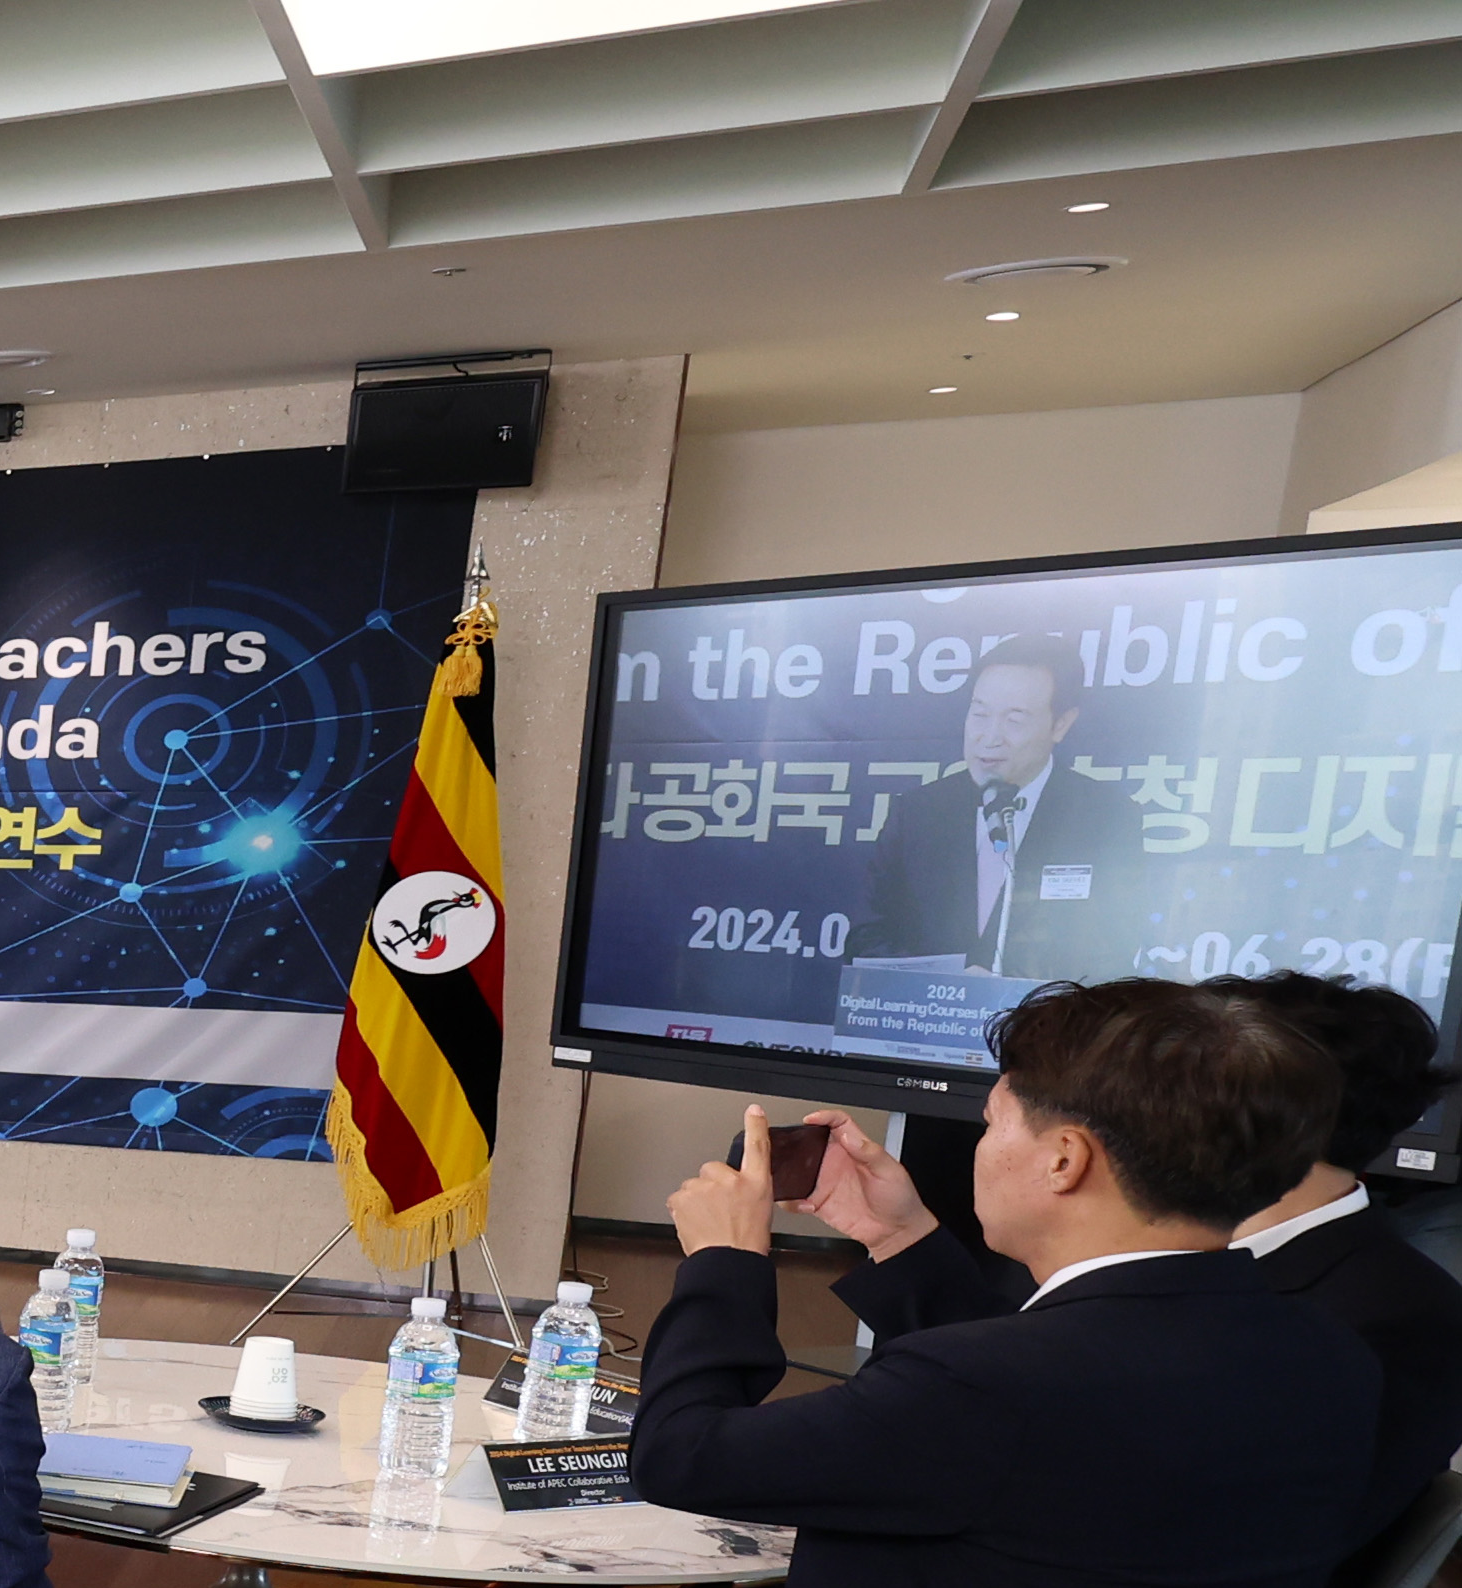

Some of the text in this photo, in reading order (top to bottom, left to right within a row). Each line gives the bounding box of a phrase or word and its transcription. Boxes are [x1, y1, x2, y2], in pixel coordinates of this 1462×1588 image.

[689, 628, 823, 700] the
[927, 985, 966, 1001] 2024
[877, 999, 926, 1018] Learning
[928, 1003, 978, 1019] Courses
[848, 1013, 877, 1027] from
[882, 1016, 903, 1030] the
[908, 1018, 966, 1036] Republic
[528, 1457, 556, 1473] LEE
[547, 1479, 567, 1488] APEC
[568, 1476, 613, 1486] Collaborative
